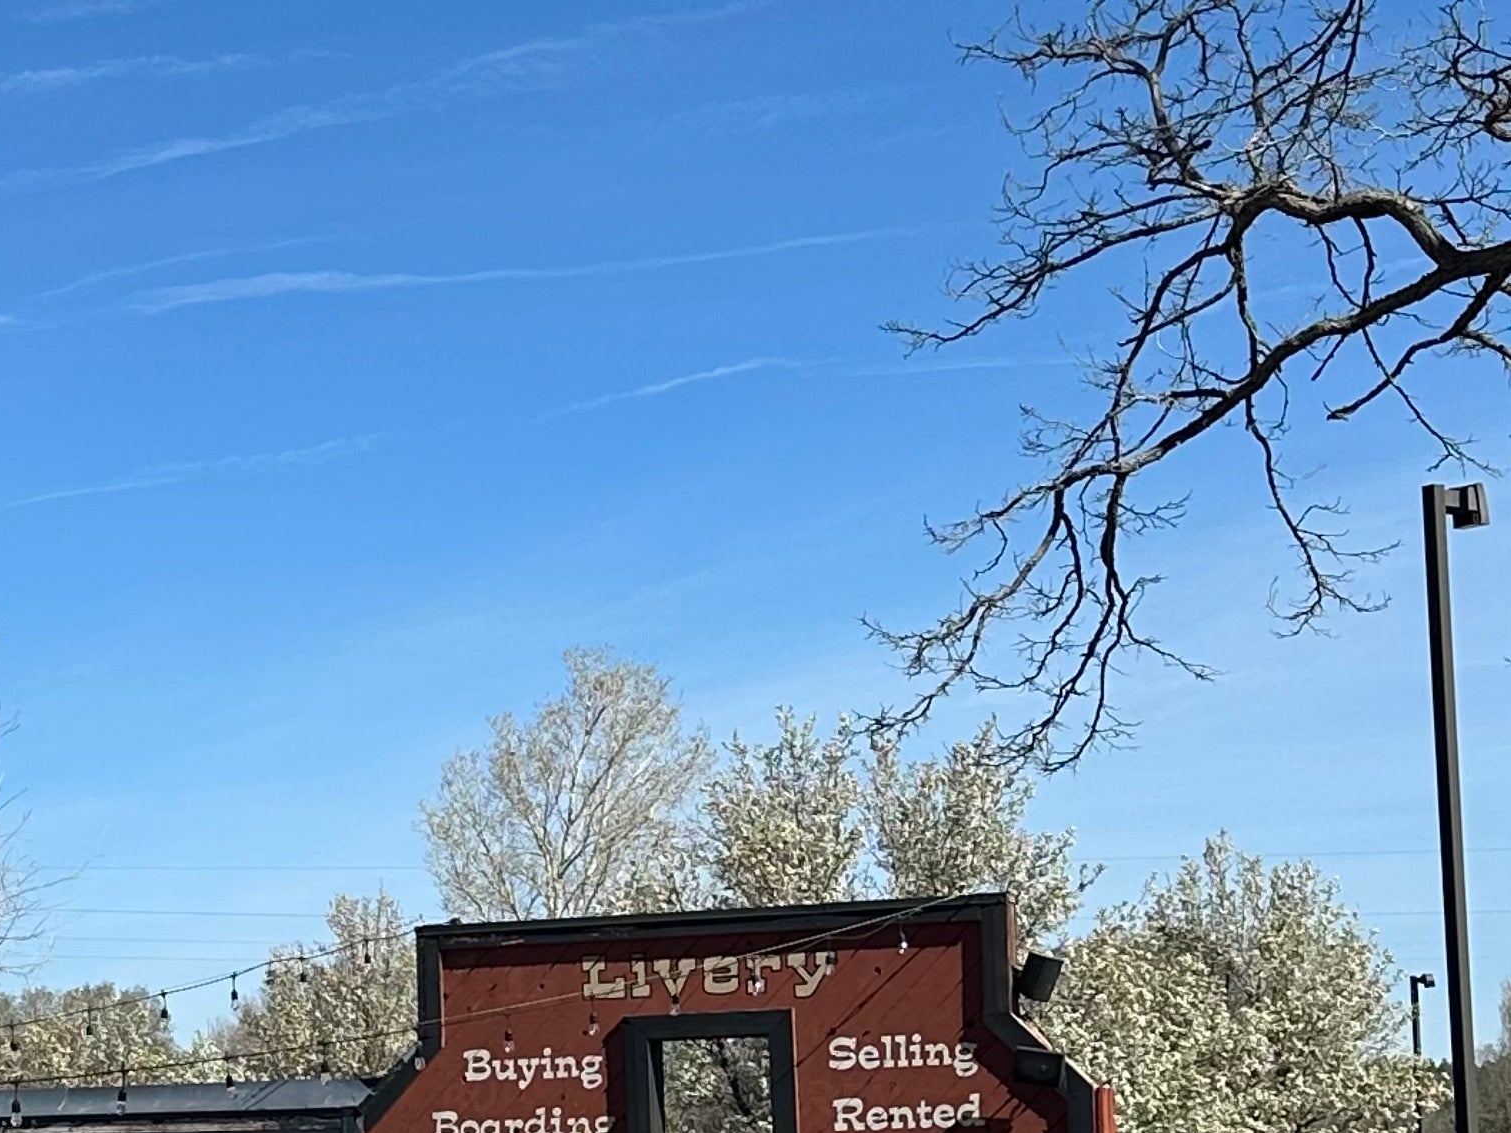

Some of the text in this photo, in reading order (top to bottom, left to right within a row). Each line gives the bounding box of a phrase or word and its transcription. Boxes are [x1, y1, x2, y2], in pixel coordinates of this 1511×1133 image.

[580, 951, 830, 999] Livery
[463, 1047, 604, 1090] Buying
[828, 1033, 979, 1077] Selling
[832, 1093, 986, 1132] Rented
